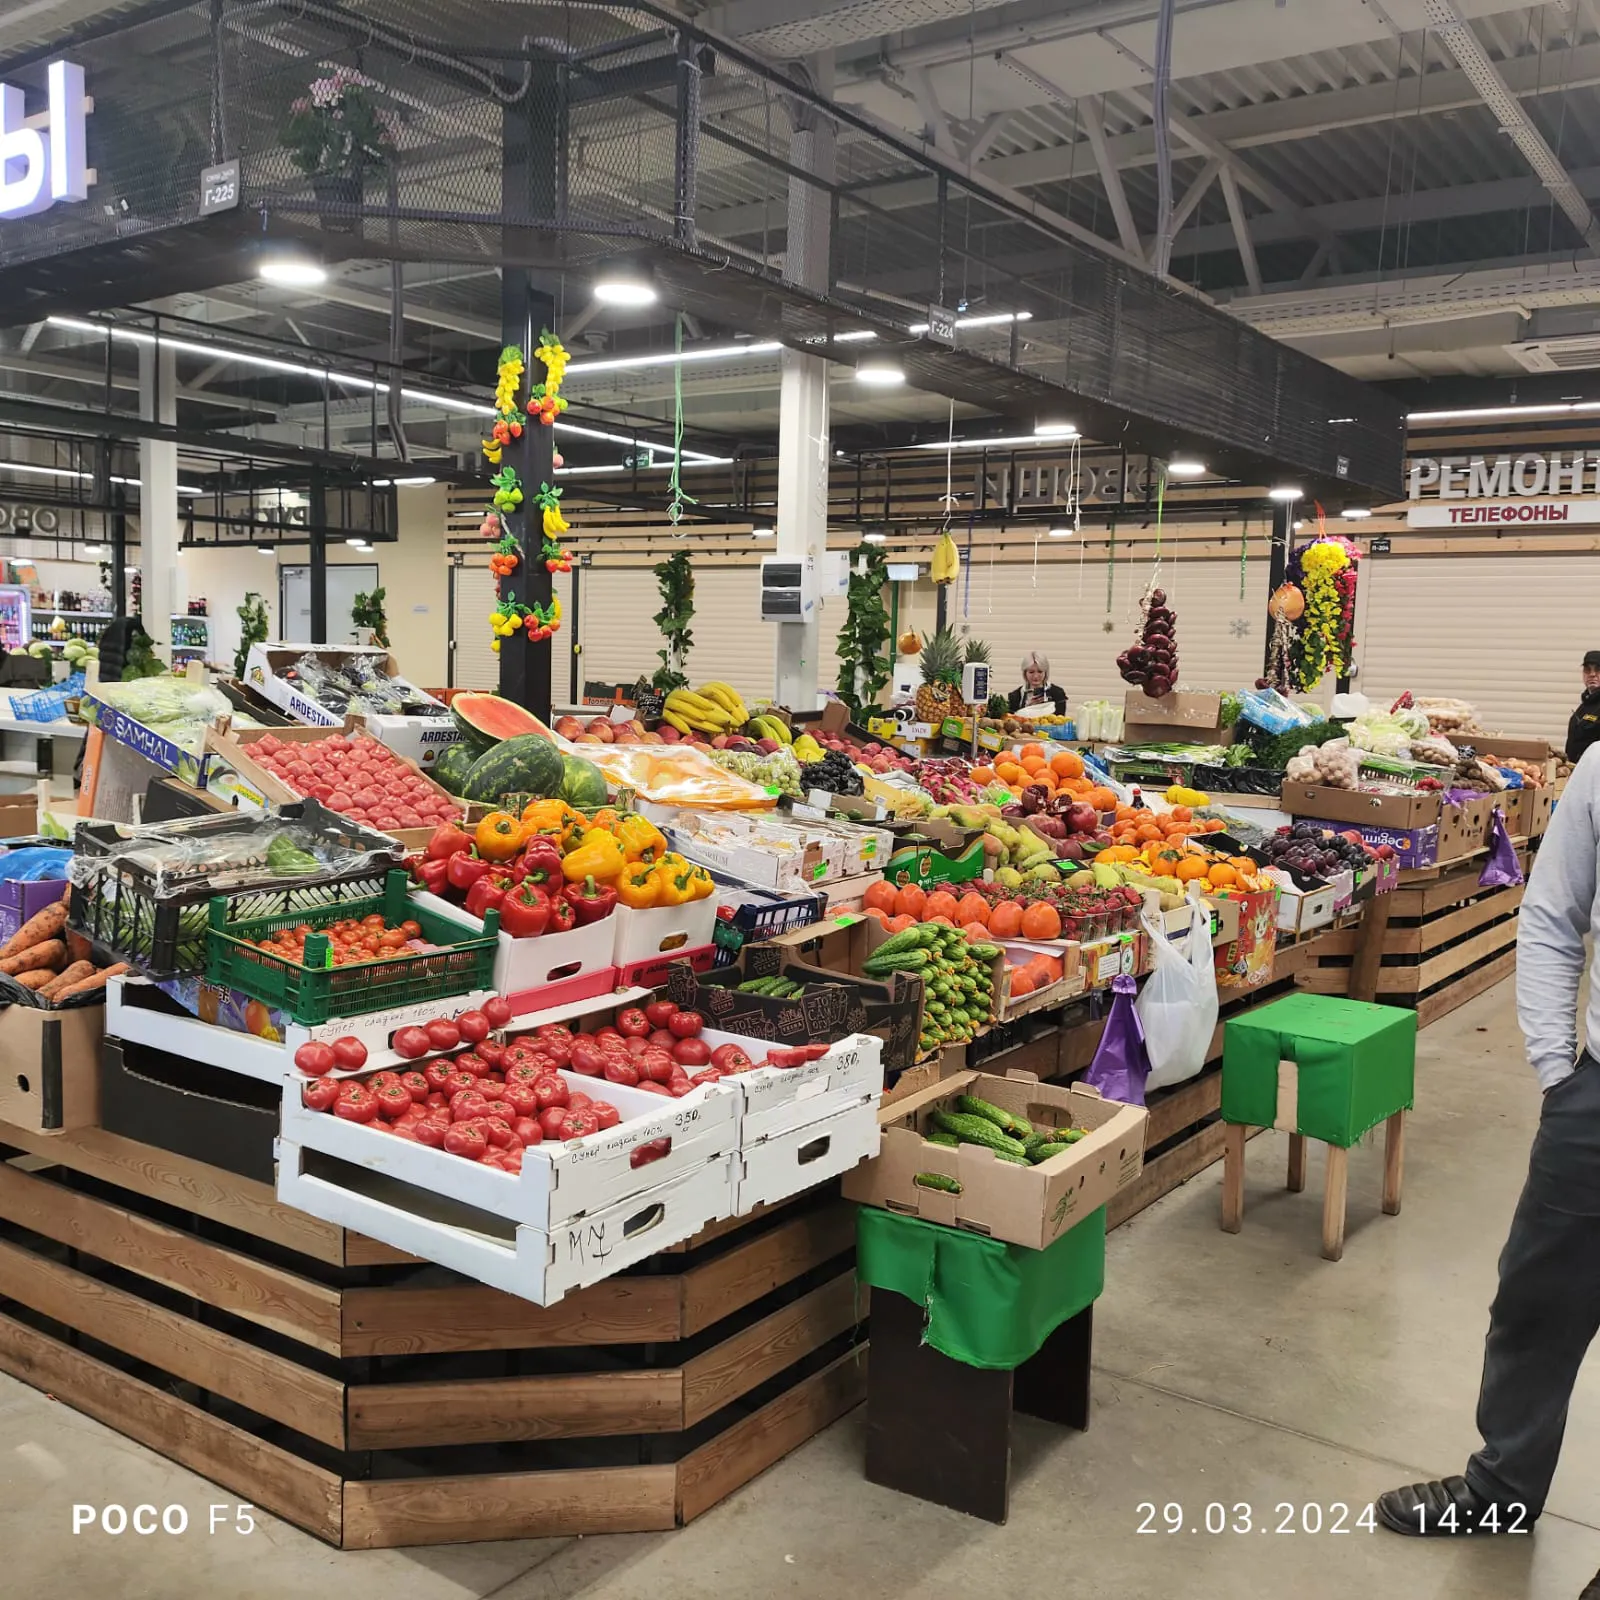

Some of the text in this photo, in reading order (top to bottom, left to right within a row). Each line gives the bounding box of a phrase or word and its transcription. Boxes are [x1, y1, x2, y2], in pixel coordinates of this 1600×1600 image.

[205, 183, 235, 206] Г-225
[931, 320, 954, 339] Г-224
[1449, 505, 1569, 523] ТЕЛЕФОНЫ
[289, 696, 335, 727] ARDESTAN
